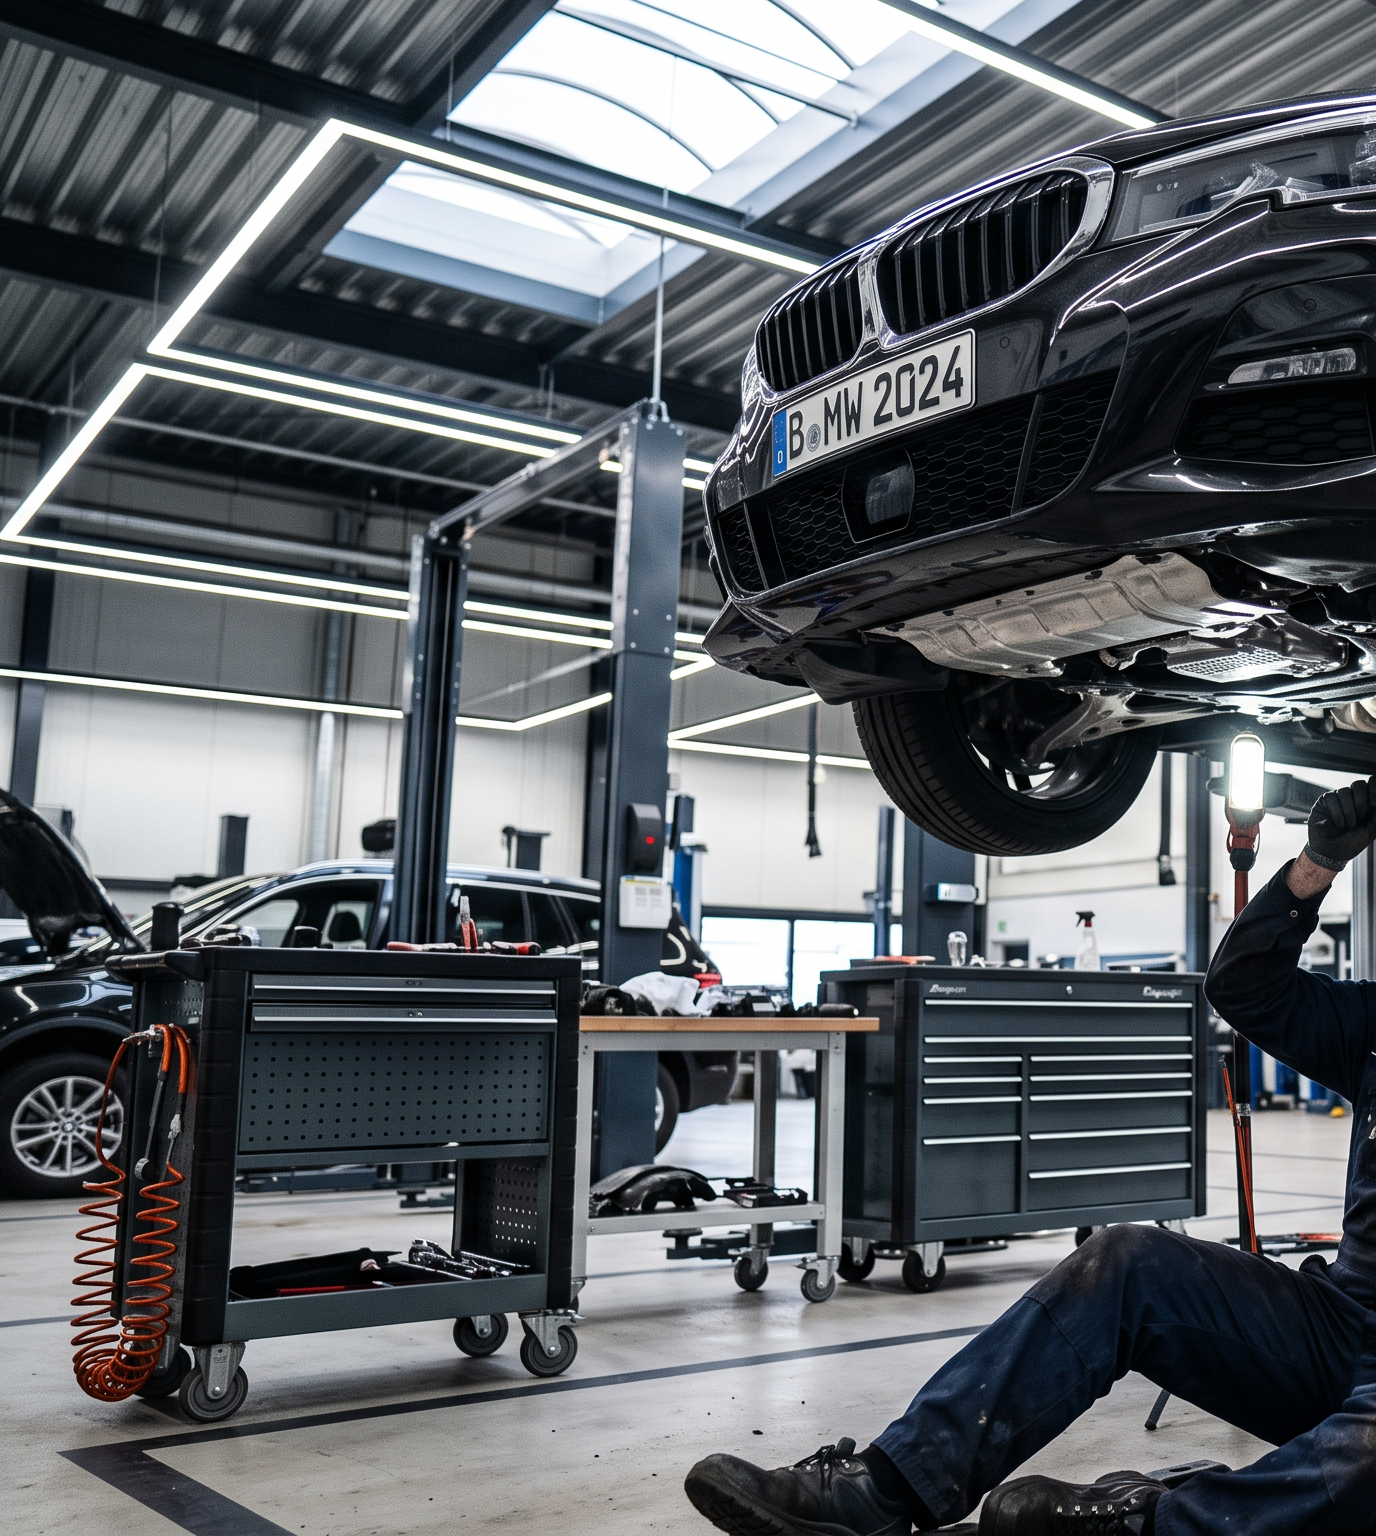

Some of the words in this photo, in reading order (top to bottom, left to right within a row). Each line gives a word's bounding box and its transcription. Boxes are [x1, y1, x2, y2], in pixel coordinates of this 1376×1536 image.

[789, 410, 805, 461] B
[823, 381, 863, 446] MW
[873, 344, 964, 427] 2024
